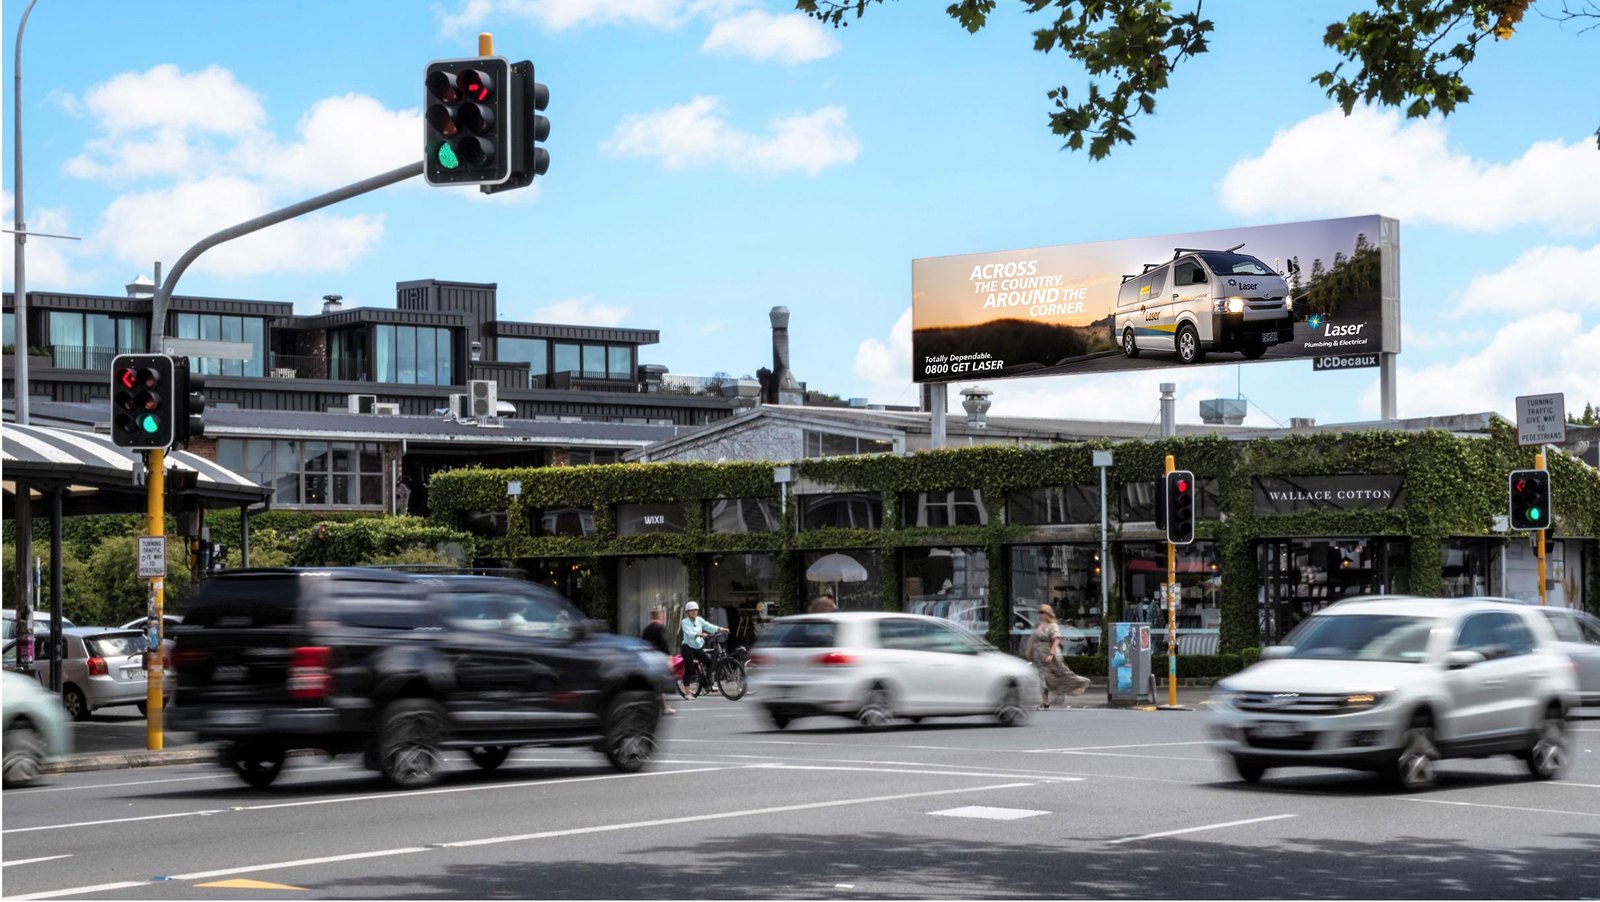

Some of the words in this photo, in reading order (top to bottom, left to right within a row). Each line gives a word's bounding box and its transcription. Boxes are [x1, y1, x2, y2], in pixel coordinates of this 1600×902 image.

[969, 260, 1037, 280] ACROSS
[975, 281, 998, 293] THE
[1001, 275, 1063, 291] COUNTRY.
[984, 288, 1059, 308] AROUND
[1062, 288, 1087, 301] THE
[1030, 302, 1087, 317] CORNER.
[1145, 311, 1160, 321] Laser
[1324, 323, 1363, 337] Laser
[1340, 338, 1368, 346] Electrical
[925, 355, 948, 363] Totally
[950, 352, 993, 362] Dependable.
[1316, 356, 1376, 368] JCDecaux
[925, 364, 948, 374] 0800
[951, 362, 970, 372] GET
[972, 360, 1004, 371] LASER
[1527, 398, 1553, 406] TURNING
[1528, 407, 1553, 415] TRAFFIC
[1522, 432, 1562, 441] PEDESTRIANS
[1269, 490, 1332, 500] WALLACE
[1337, 490, 1391, 499] COTTON
